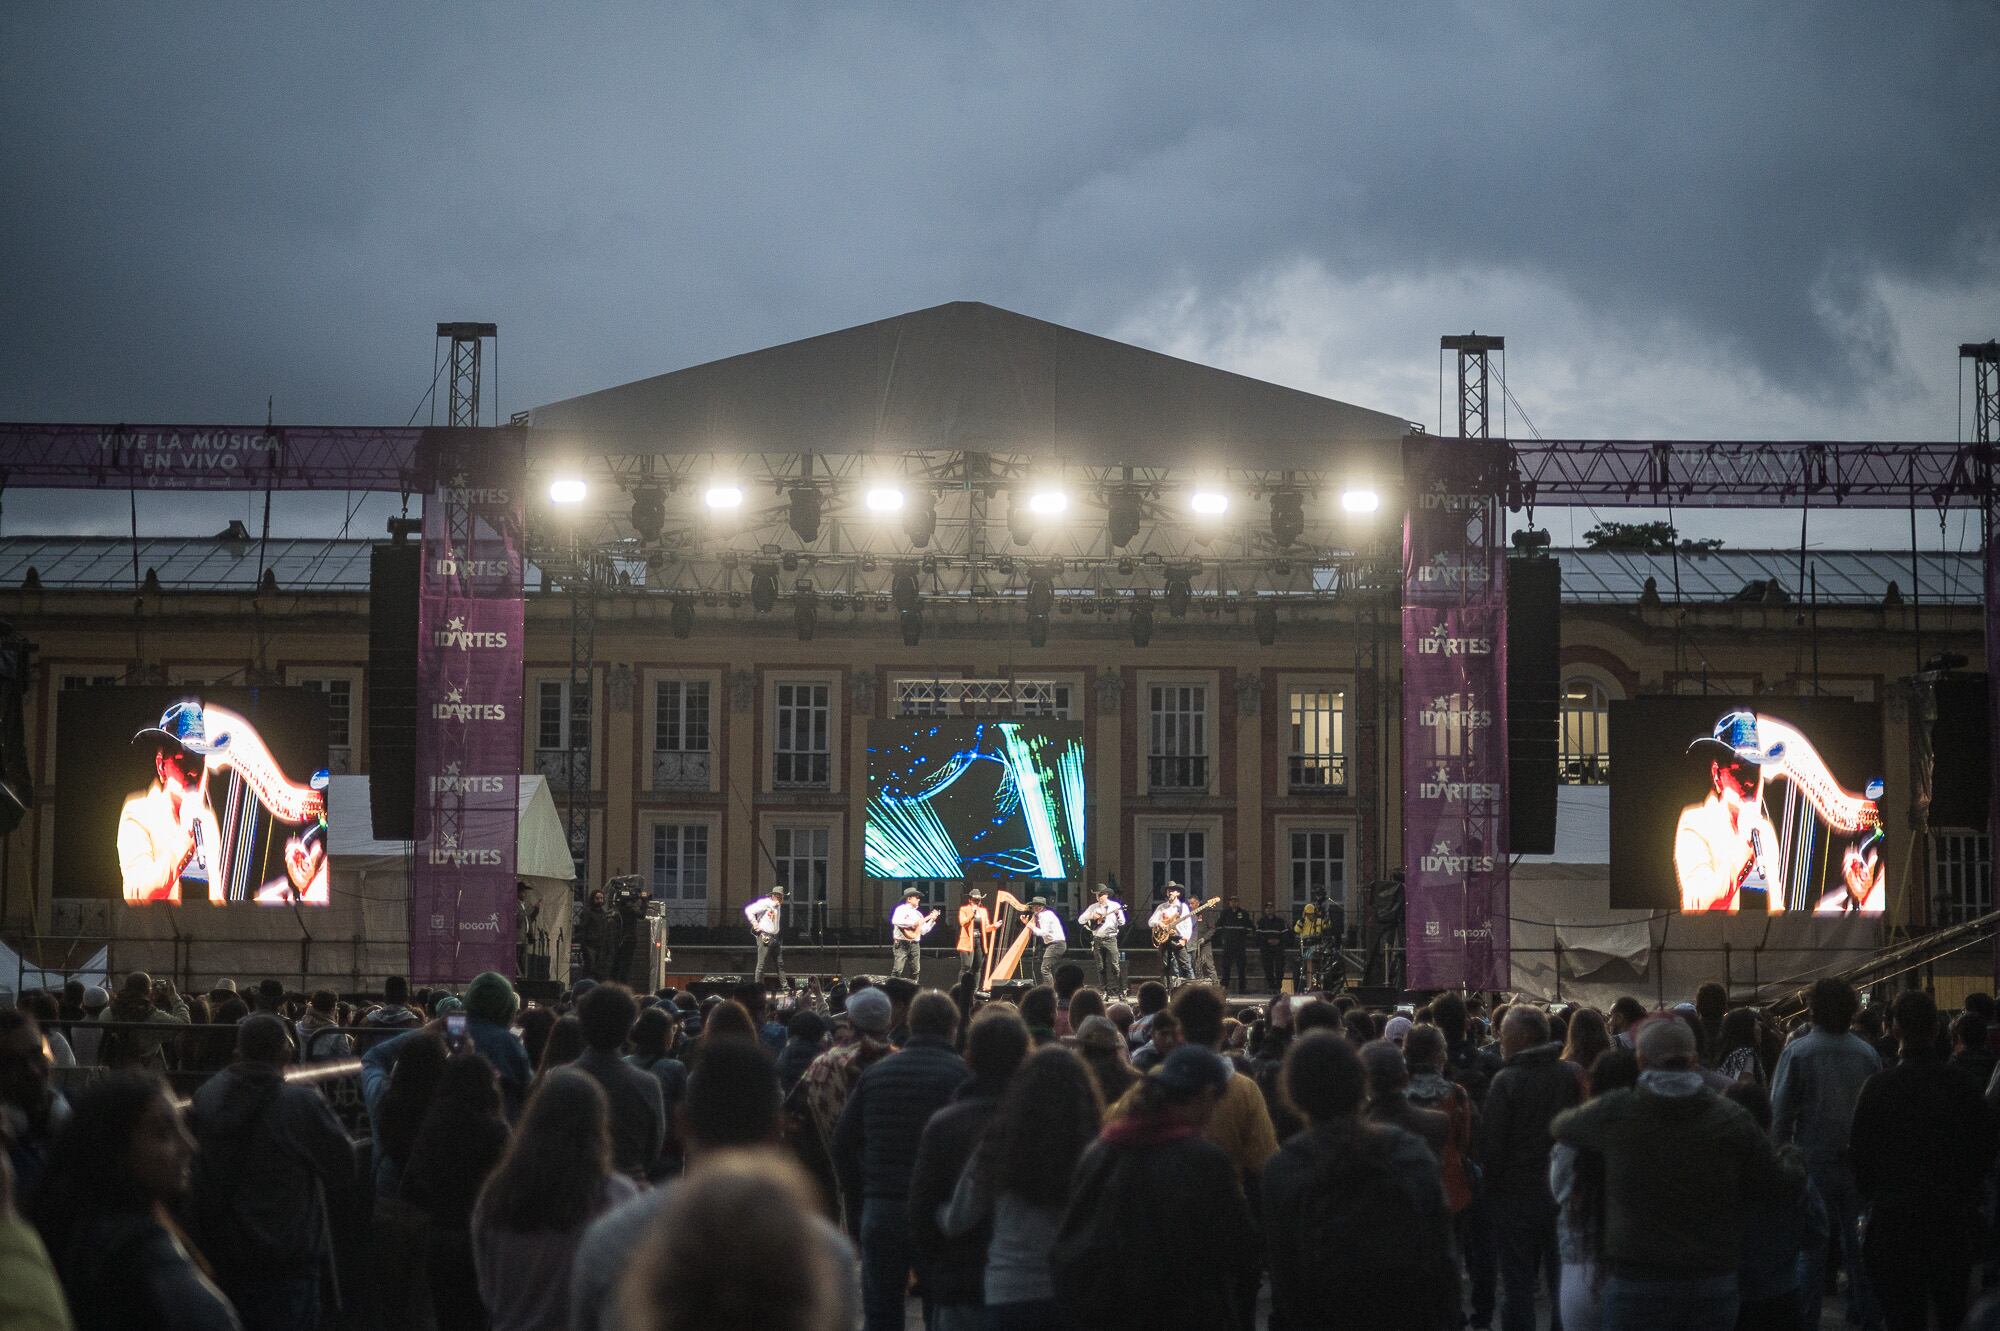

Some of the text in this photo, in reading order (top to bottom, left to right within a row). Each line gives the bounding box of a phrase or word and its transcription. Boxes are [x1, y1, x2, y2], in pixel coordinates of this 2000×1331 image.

[97, 431, 281, 451] VIVE LA MÚSICA
[143, 453, 238, 470] EN VIVO
[438, 487, 510, 507] IDARTES
[436, 559, 508, 579] IDARTES
[1418, 566, 1490, 585] IDARTES
[434, 631, 507, 651] IDARTES
[1418, 638, 1491, 657] IDARTES
[432, 704, 506, 723] IDARTES
[1419, 711, 1492, 729] IDARTES
[430, 776, 504, 796] IDARTES
[1420, 782, 1494, 802] IDARTES
[428, 850, 501, 869] IDARTES
[1420, 856, 1494, 875] IDARTES
